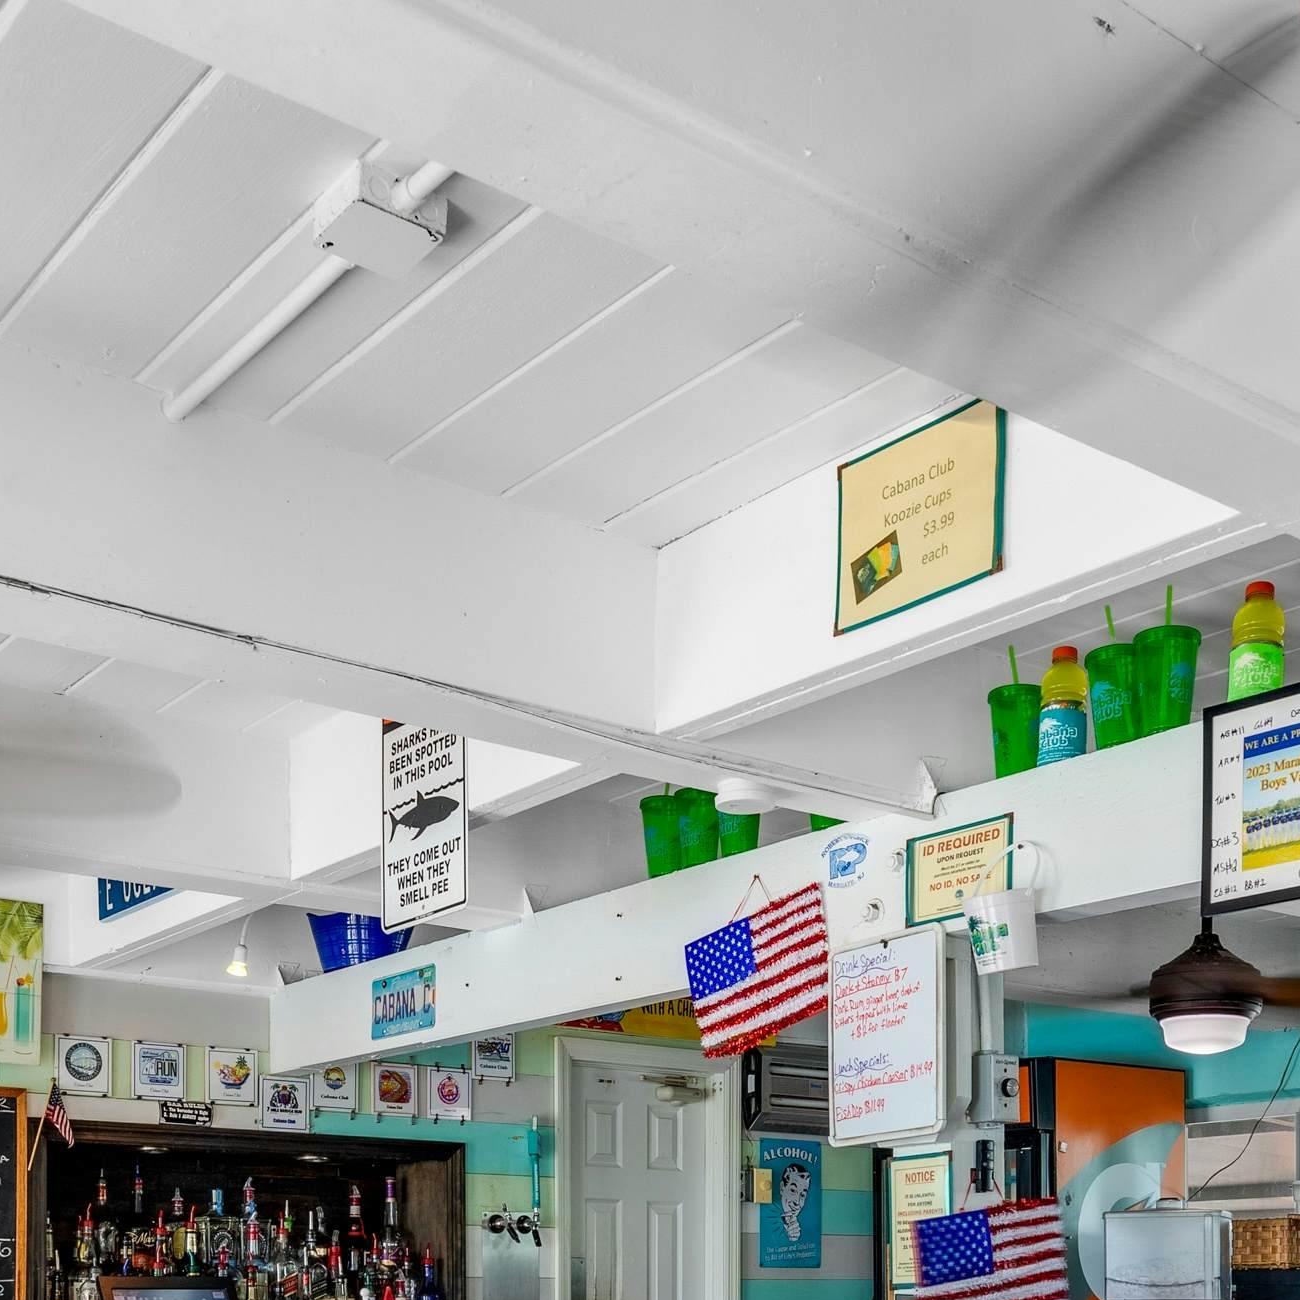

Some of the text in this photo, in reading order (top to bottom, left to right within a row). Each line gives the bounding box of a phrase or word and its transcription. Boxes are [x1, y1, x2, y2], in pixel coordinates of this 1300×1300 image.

[882, 458, 955, 500] Cabana Club
[884, 488, 952, 528] Koozie Cups
[923, 512, 955, 539] $3.99
[921, 543, 948, 565] each
[391, 727, 427, 756] SHARKS
[1244, 738, 1259, 752] WE
[1261, 734, 1280, 748] ARE
[1282, 733, 1289, 742] A
[389, 734, 457, 774] BEEN SPOTTED
[393, 752, 453, 791] IN THIS POOL
[1246, 763, 1271, 779] 2023
[1261, 776, 1287, 791] Boys
[923, 828, 1000, 857] ID REQUIRED
[388, 837, 461, 877] THEY COME OUT
[937, 847, 984, 864] UPON REQUEST
[397, 859, 451, 890] WHEN THEY
[929, 872, 991, 892] NO ID, NO SAE
[400, 878, 449, 908] SMELL PEE
[835, 955, 858, 976] Drink
[641, 999, 695, 1018] WITH A CHA
[877, 1004, 890, 1017] with
[893, 1001, 908, 1012] lime
[156, 1061, 177, 1078] RUN
[835, 1057, 853, 1075] Lunch
[836, 1098, 885, 1121] Fish Dip $11.99
[763, 1147, 818, 1165] ALCOHOL!
[905, 1171, 935, 1184] NOTICE
